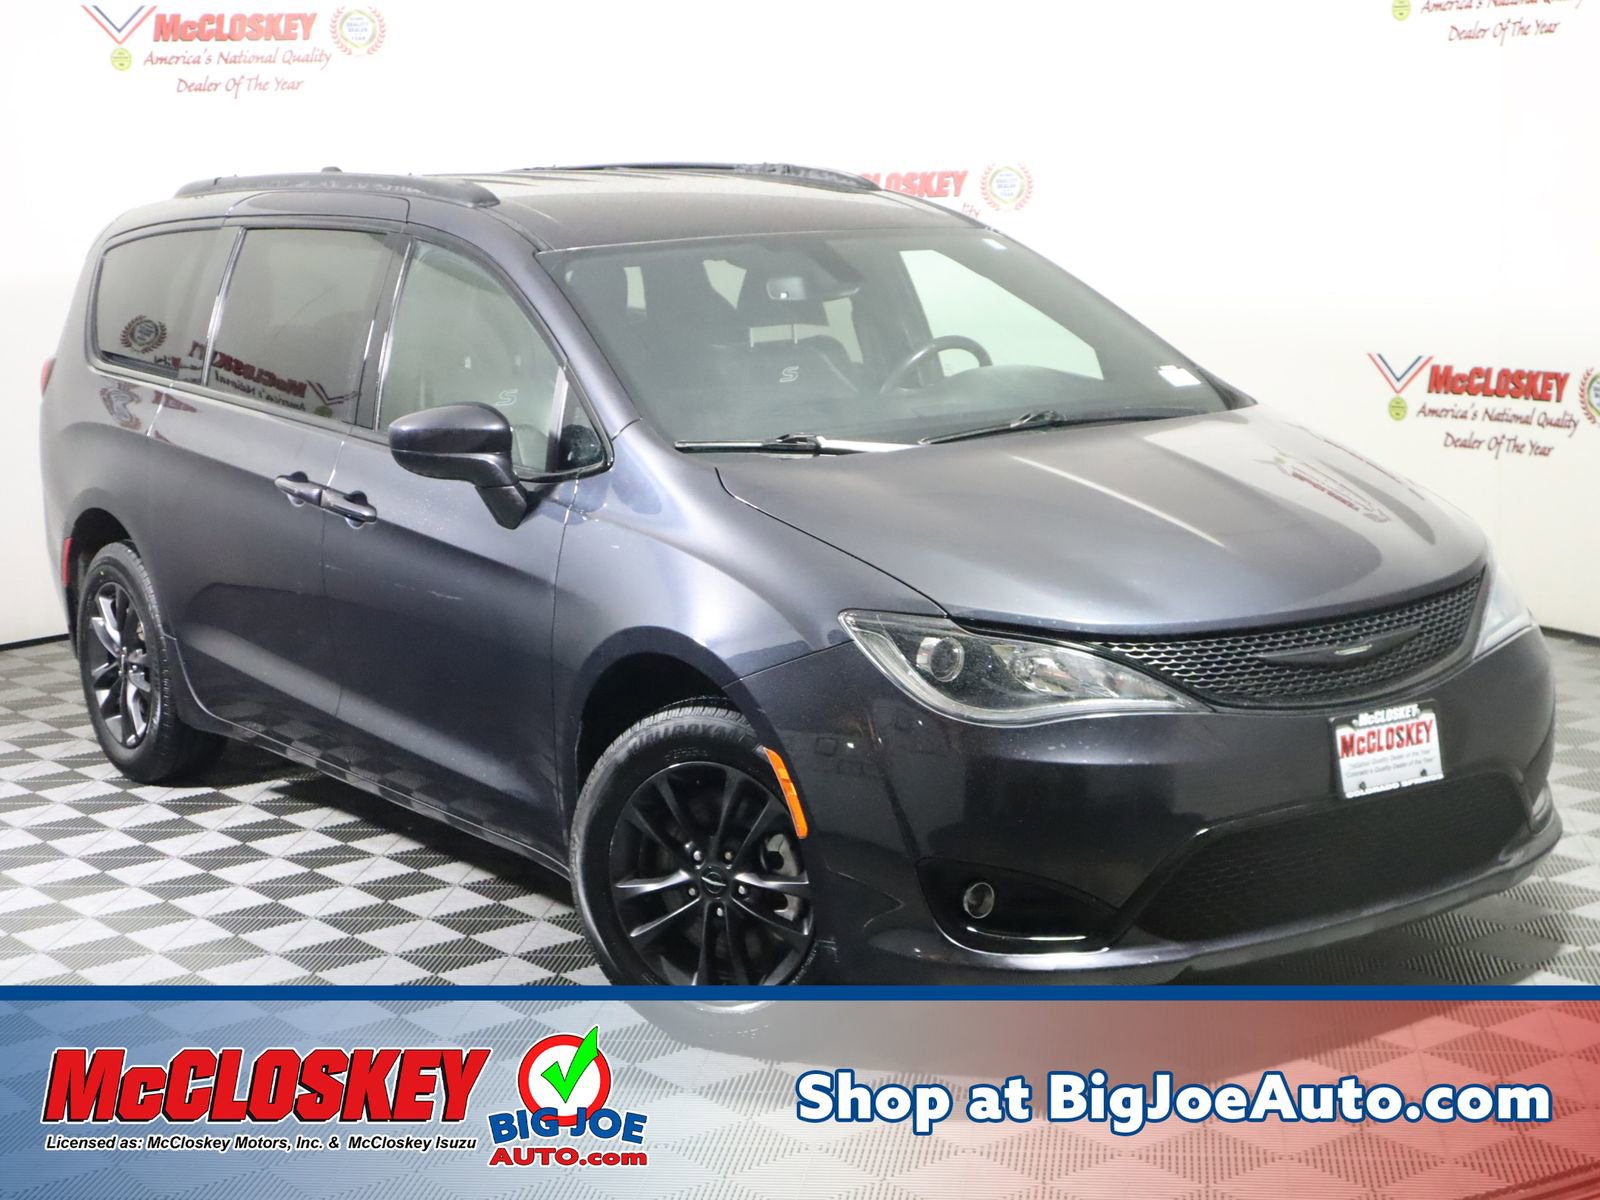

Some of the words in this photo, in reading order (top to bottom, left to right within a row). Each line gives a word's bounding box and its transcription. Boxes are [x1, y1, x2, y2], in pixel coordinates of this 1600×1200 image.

[153, 12, 318, 42] McCLOSKEY
[1448, 20, 1490, 41] Dealer
[1492, 19, 1511, 46] Of
[1510, 17, 1531, 37] The
[1534, 19, 1561, 36] Year
[143, 49, 212, 66] America's
[216, 47, 279, 65] National
[281, 47, 332, 70] Quality
[176, 75, 222, 93] Dealer
[224, 75, 245, 100] Of
[247, 75, 270, 92] The
[274, 77, 304, 92] Year
[1427, 364, 1570, 403] McCLOSKEY
[1416, 403, 1478, 421] America's
[1482, 407, 1535, 426] National
[1536, 410, 1580, 438] Quality
[1443, 431, 1486, 449] Dealer
[1487, 433, 1506, 460] Of
[1505, 436, 1526, 455] The
[1528, 443, 1555, 458] Year
[1340, 719, 1433, 758] McCLOSKEY
